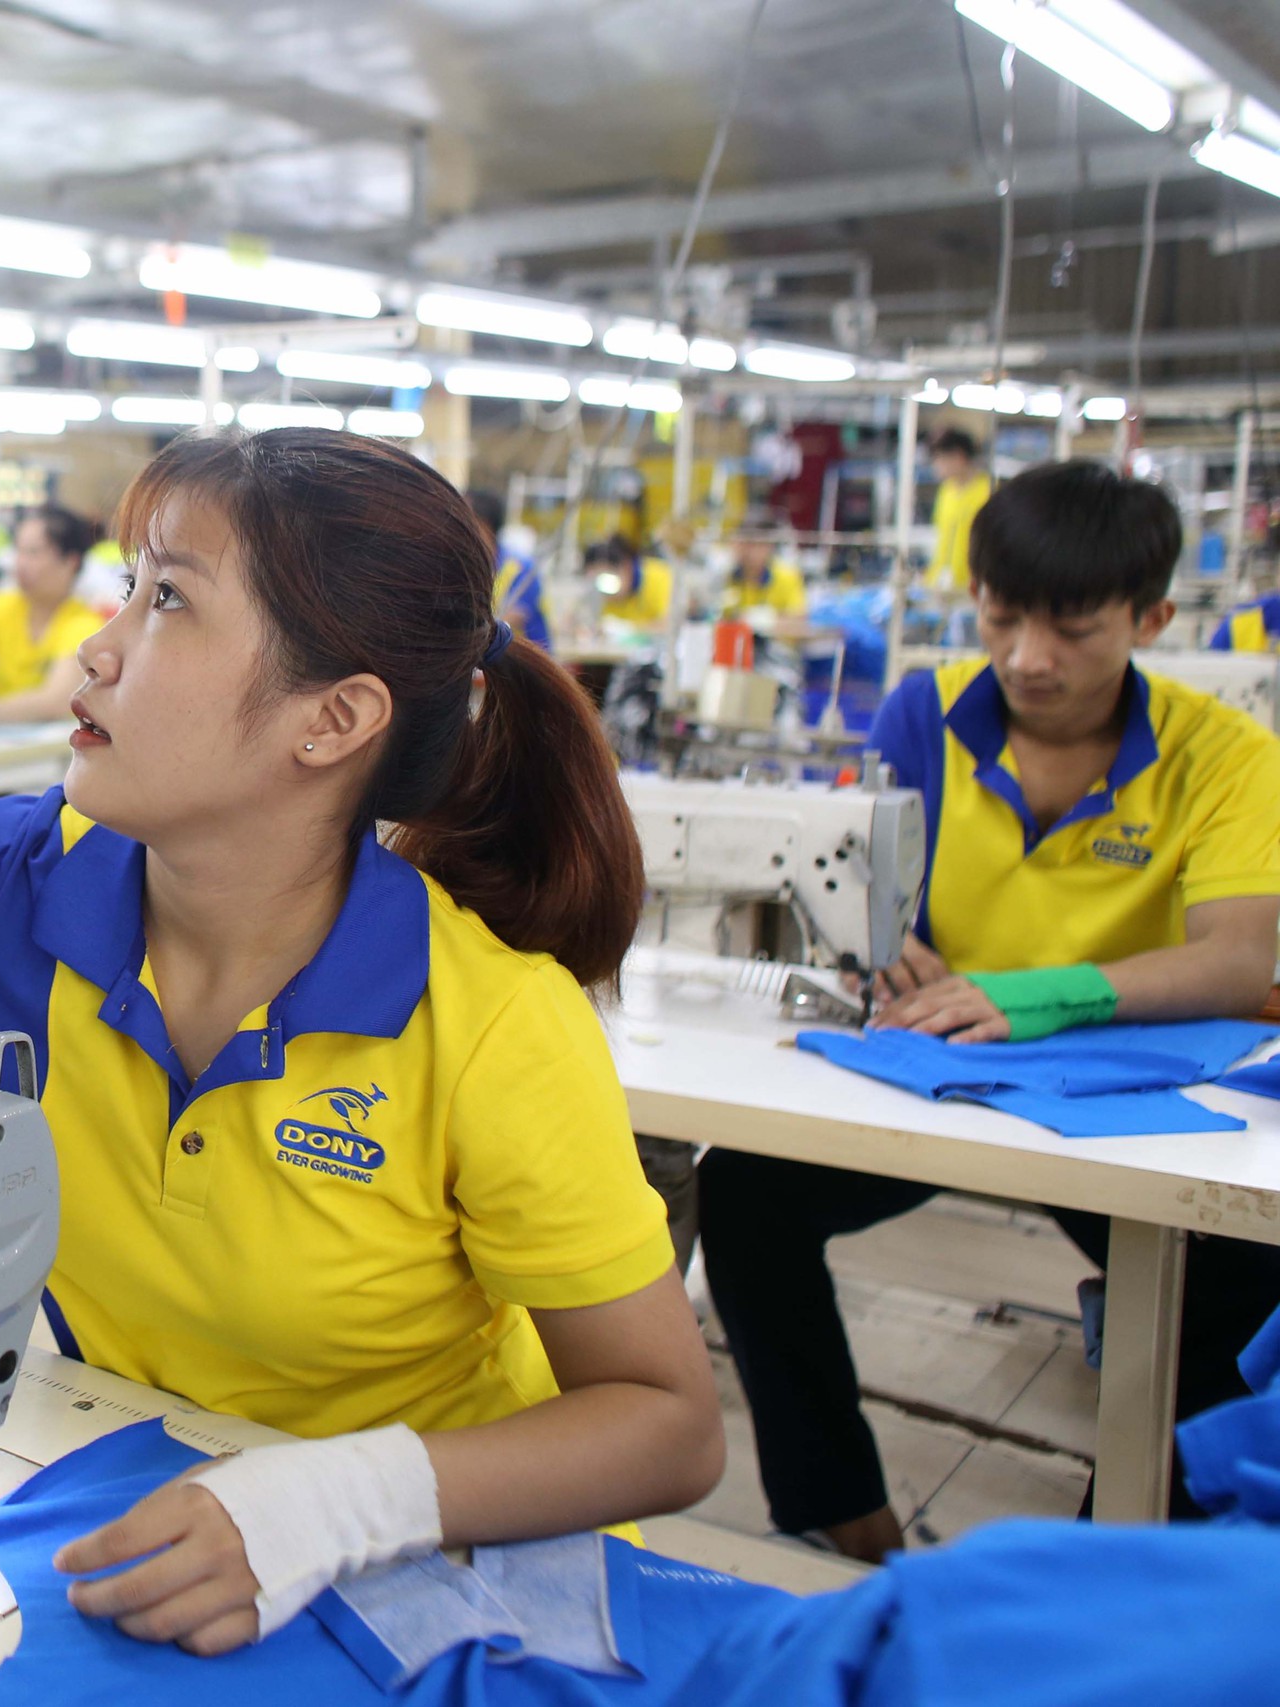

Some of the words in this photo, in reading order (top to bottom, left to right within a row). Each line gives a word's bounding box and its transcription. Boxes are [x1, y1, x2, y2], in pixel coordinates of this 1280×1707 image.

[282, 1125, 379, 1162] DONY
[277, 1150, 309, 1168] EVER
[310, 1160, 373, 1184] GROWING
